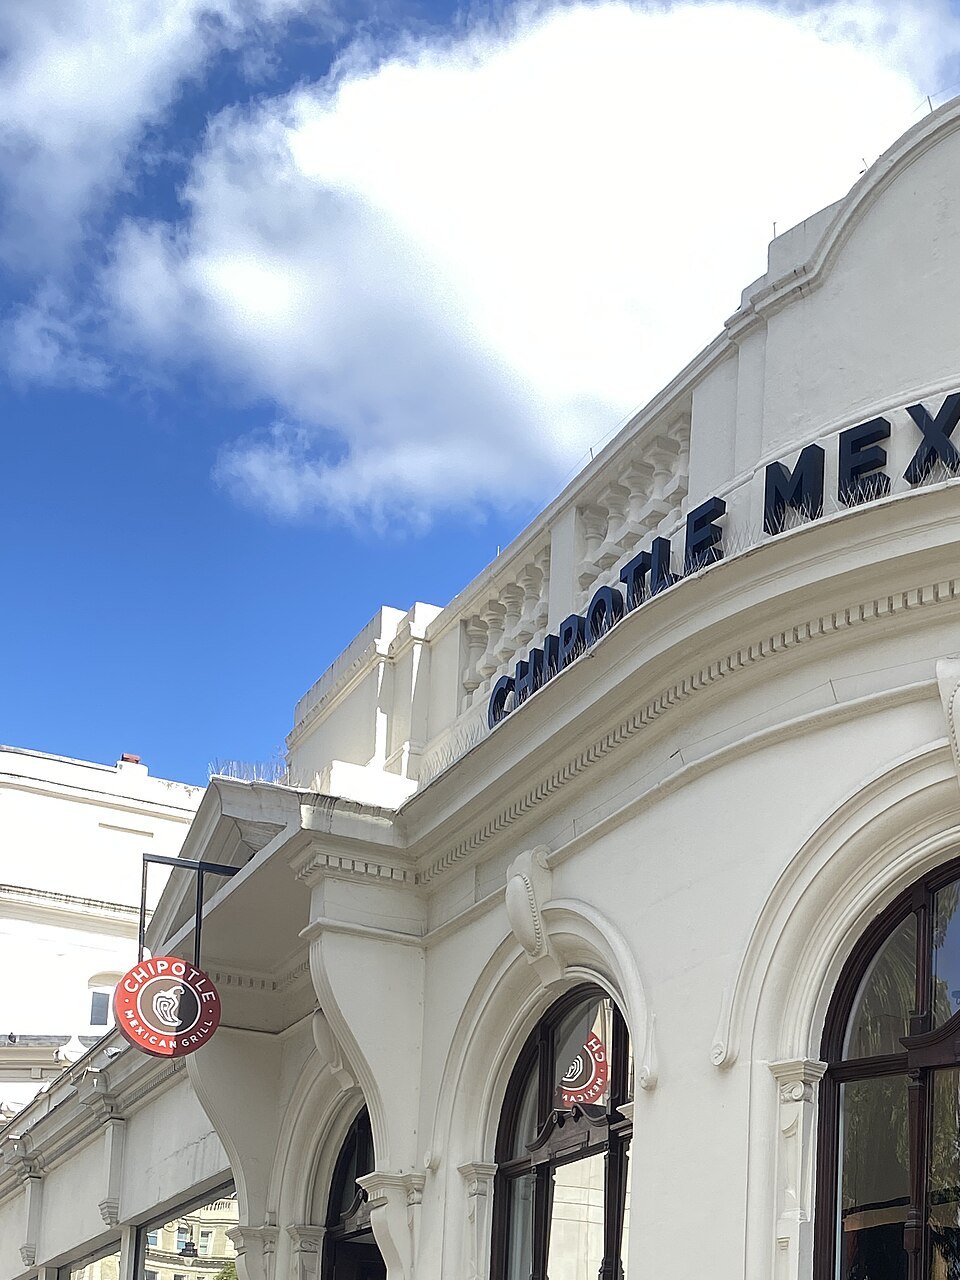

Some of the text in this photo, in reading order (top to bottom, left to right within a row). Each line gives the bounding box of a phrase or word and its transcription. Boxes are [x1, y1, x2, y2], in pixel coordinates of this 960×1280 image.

[488, 496, 727, 730] CHIPOTLE
[124, 961, 216, 1003] CHIPOTLE
[124, 1010, 213, 1048] MEXICAN GRILL
